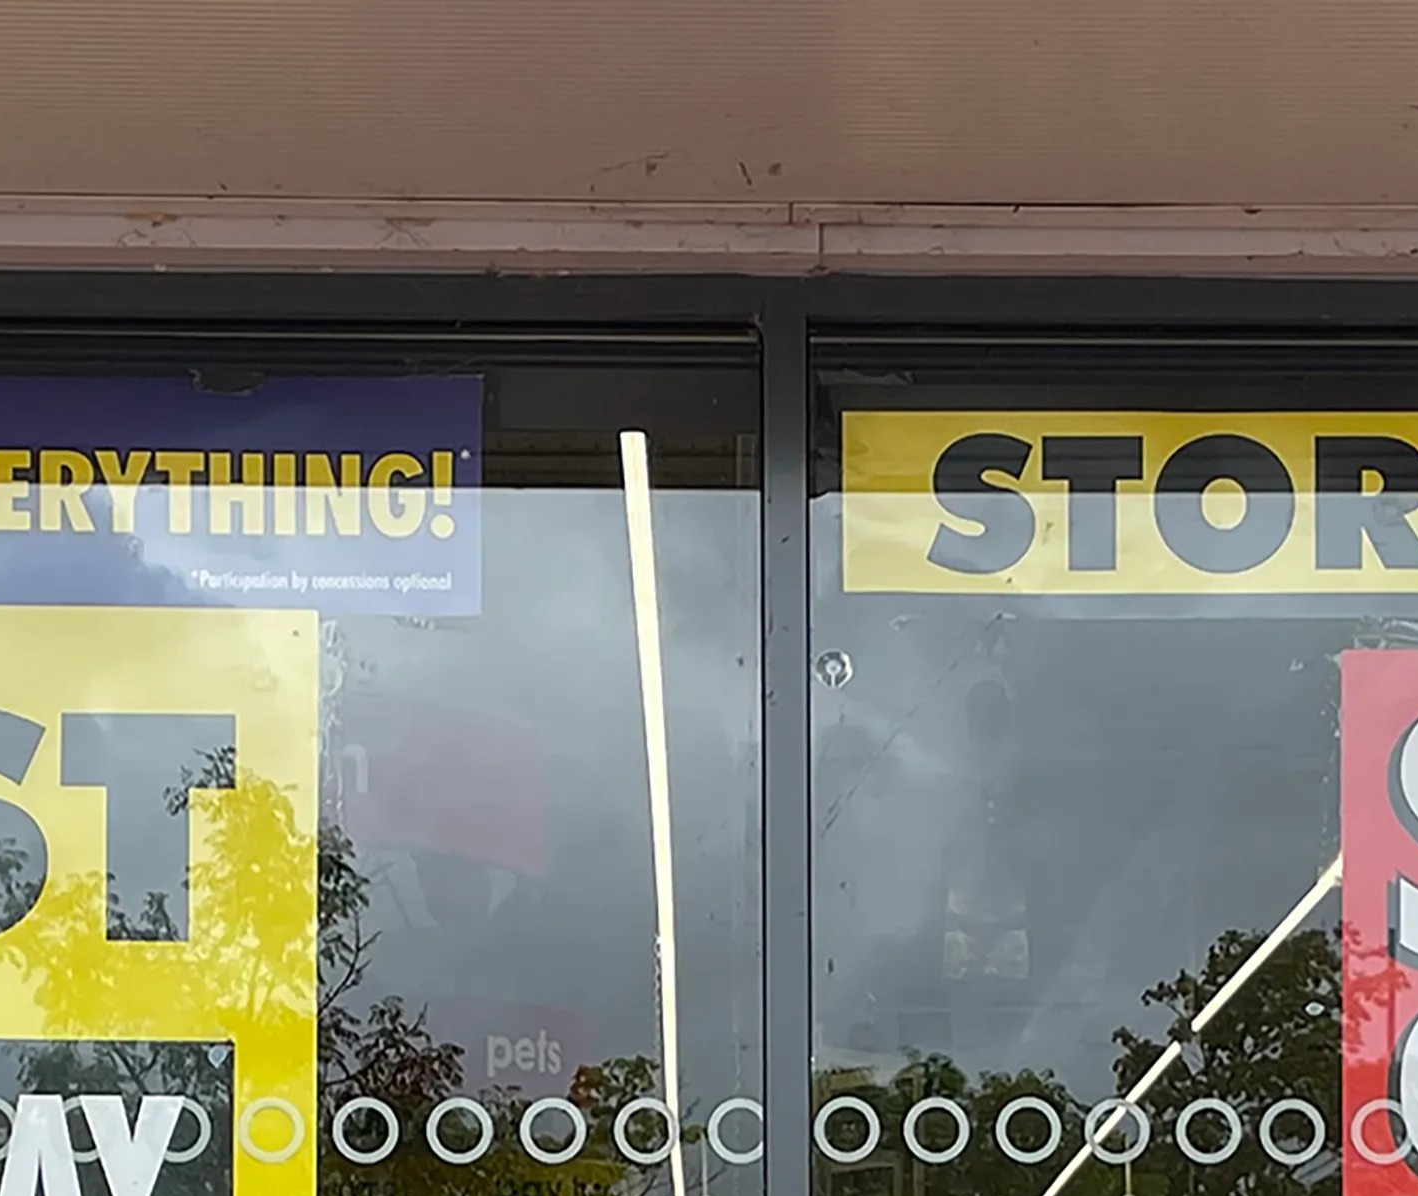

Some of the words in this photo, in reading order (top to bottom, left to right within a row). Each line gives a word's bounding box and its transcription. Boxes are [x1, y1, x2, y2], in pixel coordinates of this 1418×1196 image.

[291, 570, 308, 593] by
[311, 571, 390, 590] concessions
[393, 571, 452, 593] optional
[486, 1029, 563, 1078] pets
